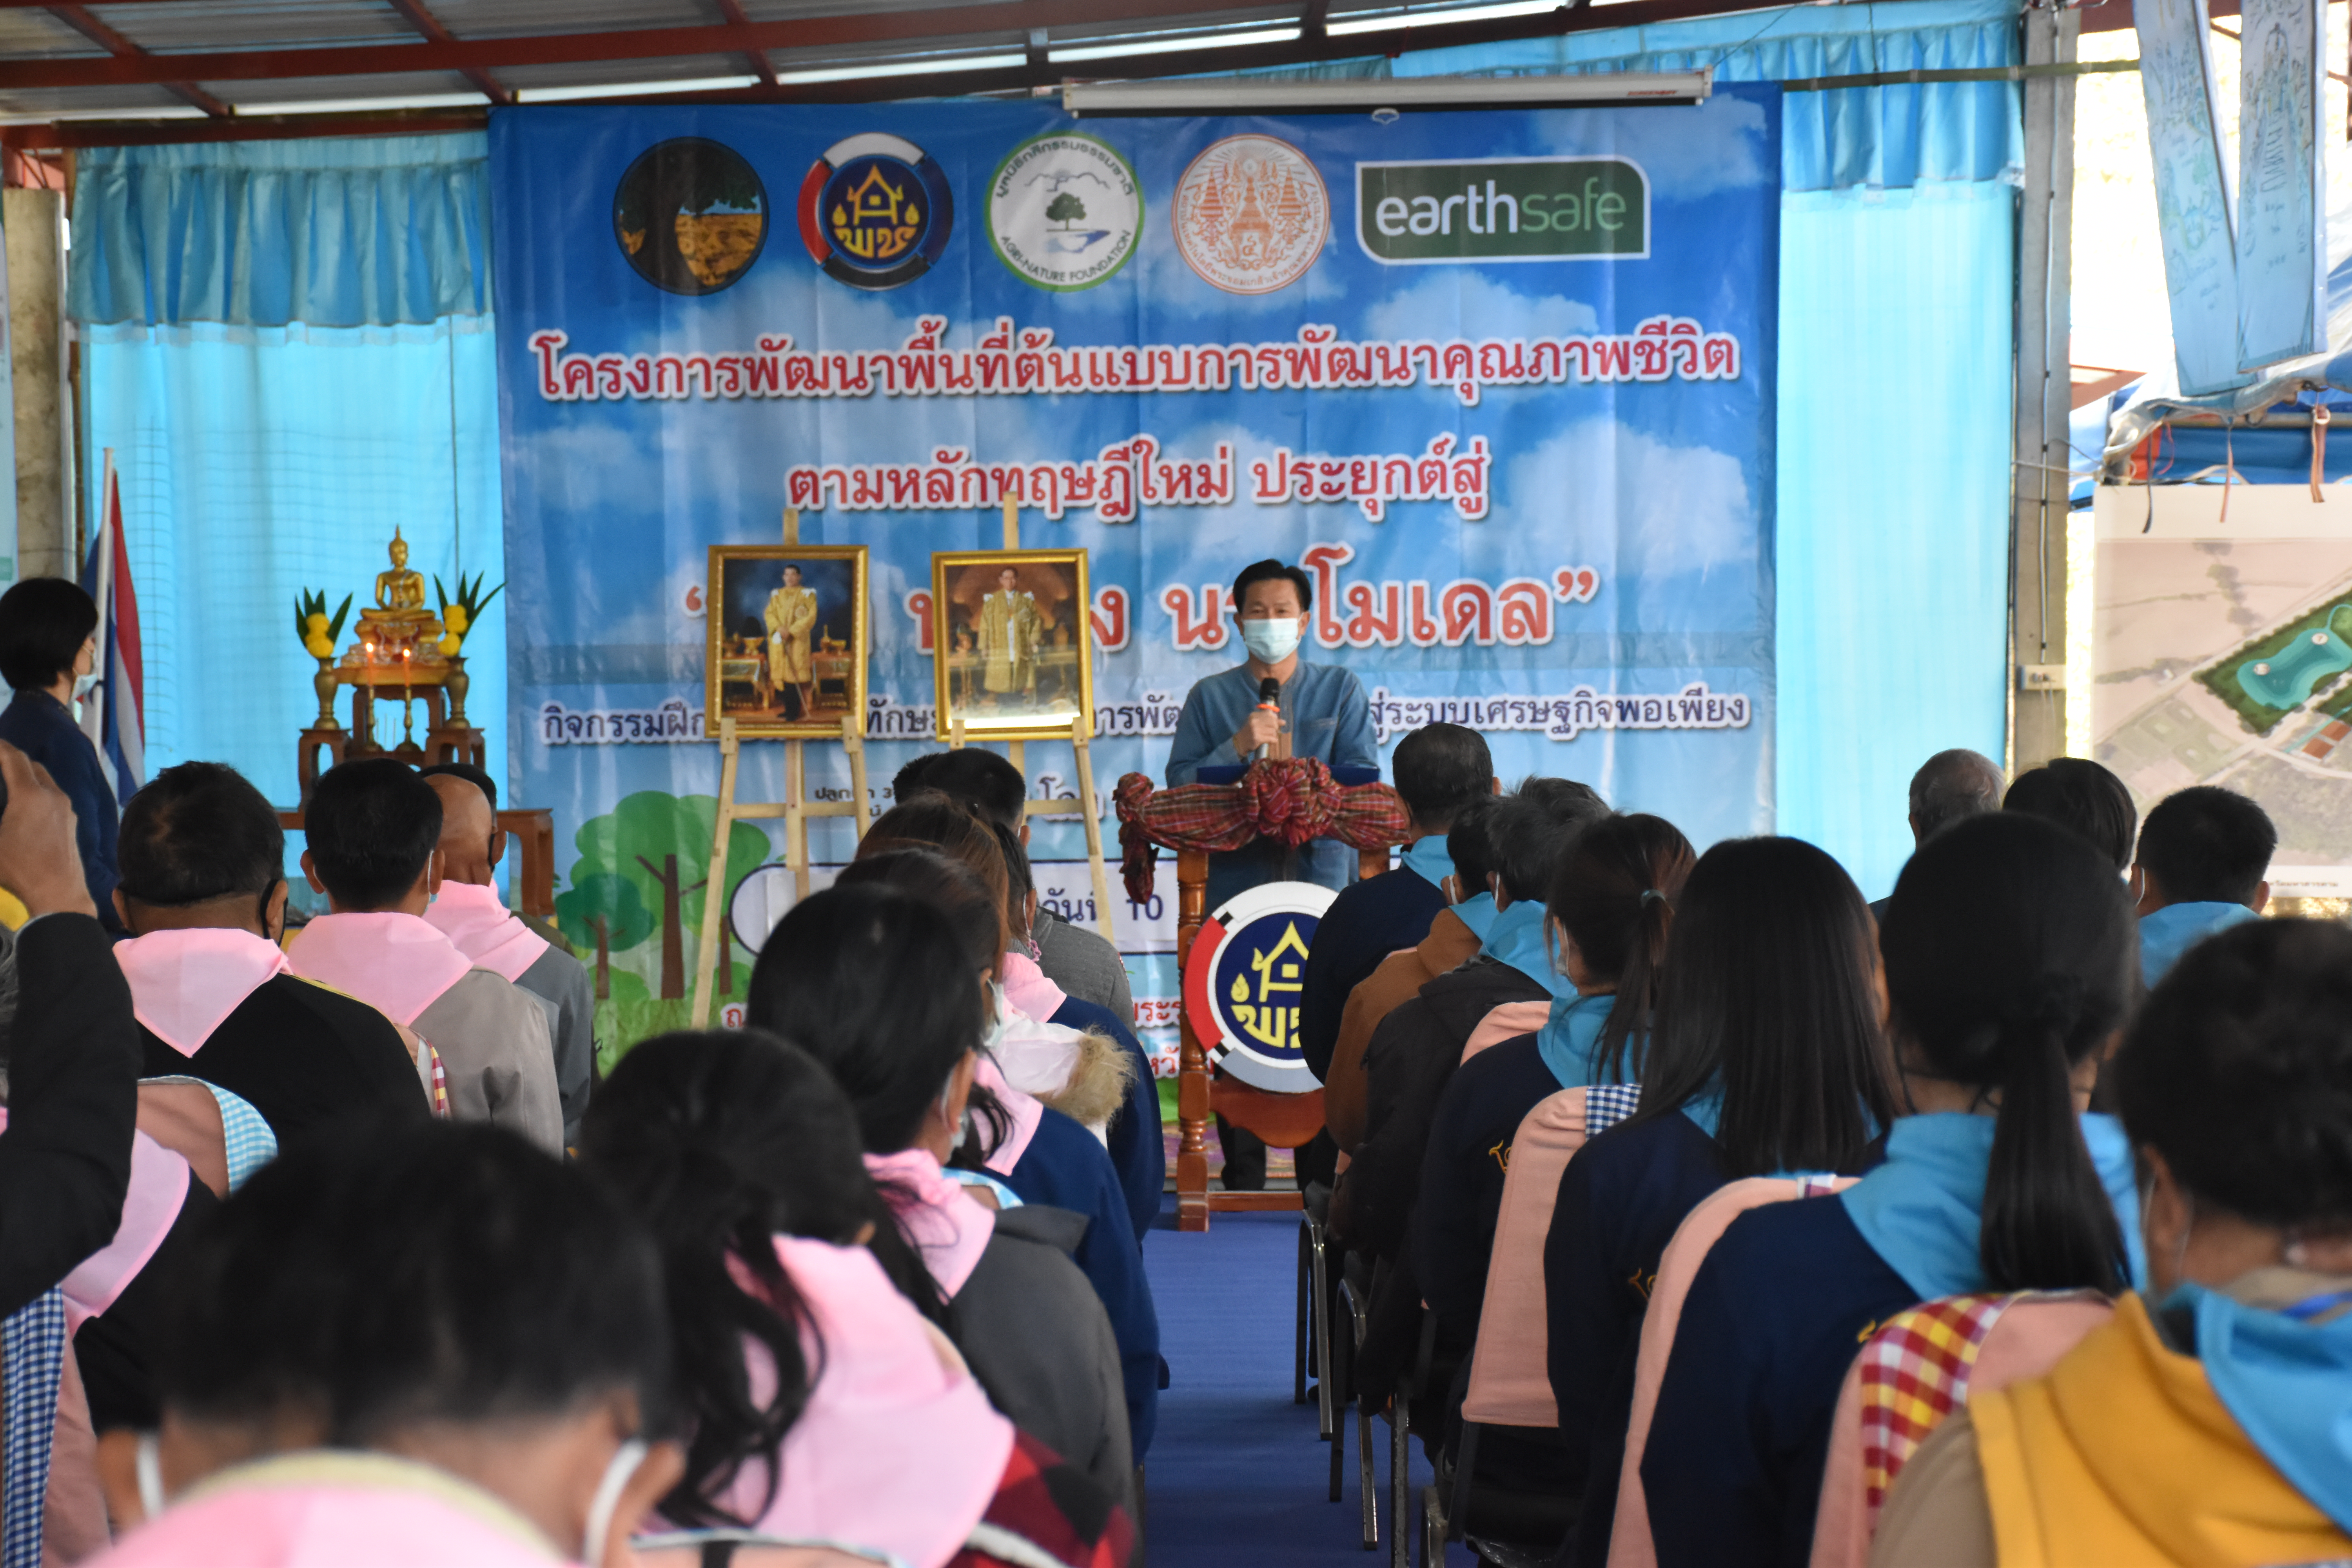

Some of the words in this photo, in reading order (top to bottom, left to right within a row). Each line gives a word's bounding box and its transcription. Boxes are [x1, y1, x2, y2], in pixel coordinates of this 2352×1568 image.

[1376, 177, 1627, 236] earthsafe
[1000, 236, 1065, 282] AGRI-NATURE
[1069, 229, 1131, 281] FOUNDATION
[534, 318, 1735, 401] โครงการพัฒนาพื้นที่ต้นแบบการพัฒนาคุณภาพชีวิต
[789, 439, 1228, 517] ตามหลักทฤษฎีใหม่
[1253, 437, 1486, 516] ประยุกต์สู่
